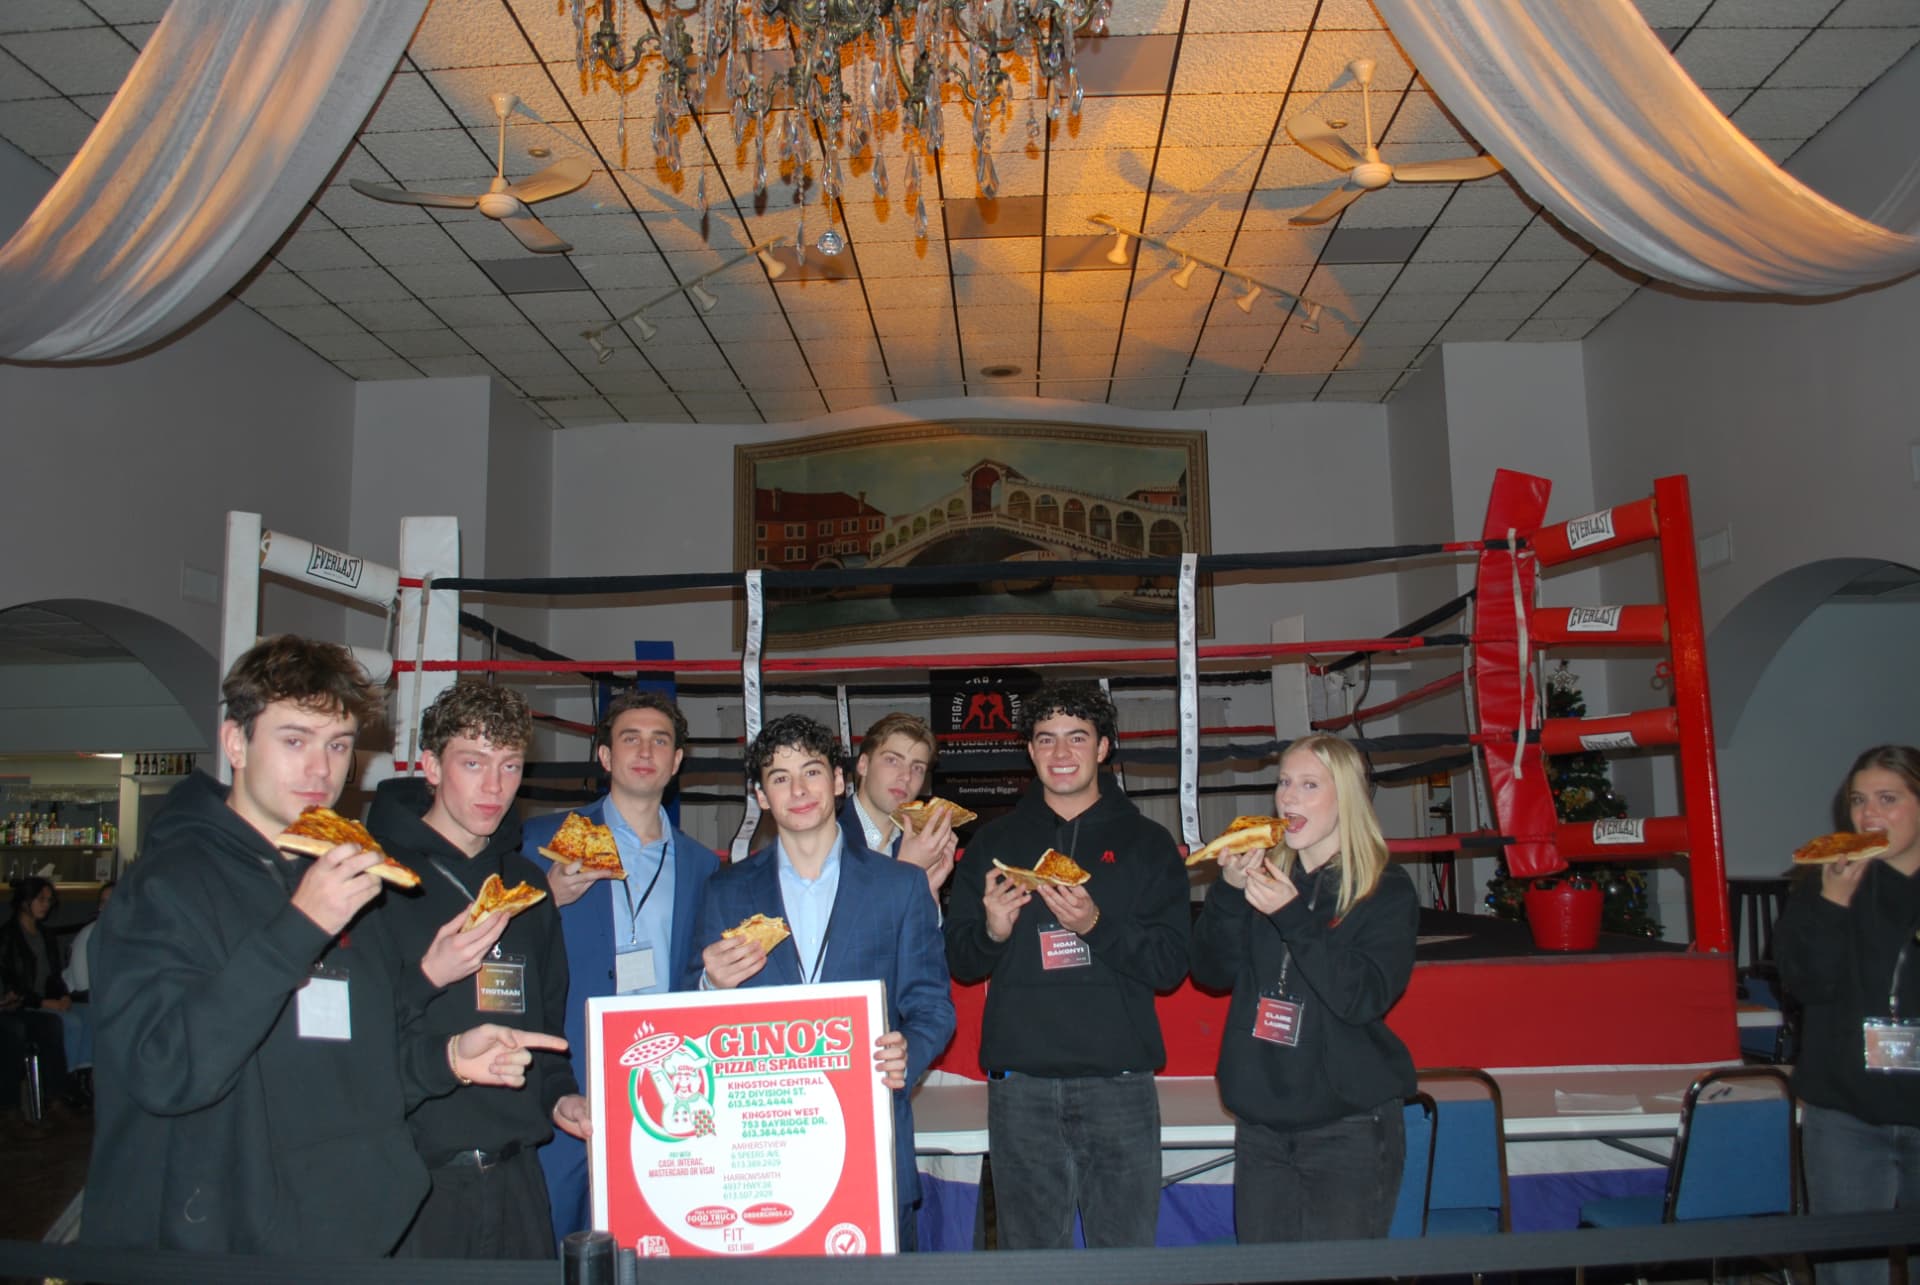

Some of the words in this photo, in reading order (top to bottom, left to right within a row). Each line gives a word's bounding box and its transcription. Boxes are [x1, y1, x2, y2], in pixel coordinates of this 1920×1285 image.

[1569, 512, 1610, 545] EVERLAST
[311, 546, 360, 581] EVERLAST
[1570, 607, 1617, 627] EVERLAST
[709, 1019, 851, 1058] GINO'S
[715, 1061, 755, 1074] PIZZA
[758, 1060, 766, 1072] &
[769, 1055, 848, 1071] SPAGHETTI
[728, 1080, 777, 1090] KINGSTON
[779, 1077, 824, 1087] CENTRAL
[728, 1091, 746, 1099] 472
[748, 1088, 790, 1098] DIVISION
[793, 1087, 806, 1096] ST.
[742, 1110, 791, 1120] KINGSTON
[794, 1107, 819, 1116] WEST
[761, 1118, 808, 1128] BAYRIDGE
[811, 1117, 828, 1125] DR.
[732, 1140, 786, 1151] AMHERSTVIEW
[687, 1214, 708, 1223] FOOD
[711, 1213, 736, 1221] TRUCK
[723, 1227, 744, 1242] FIT
